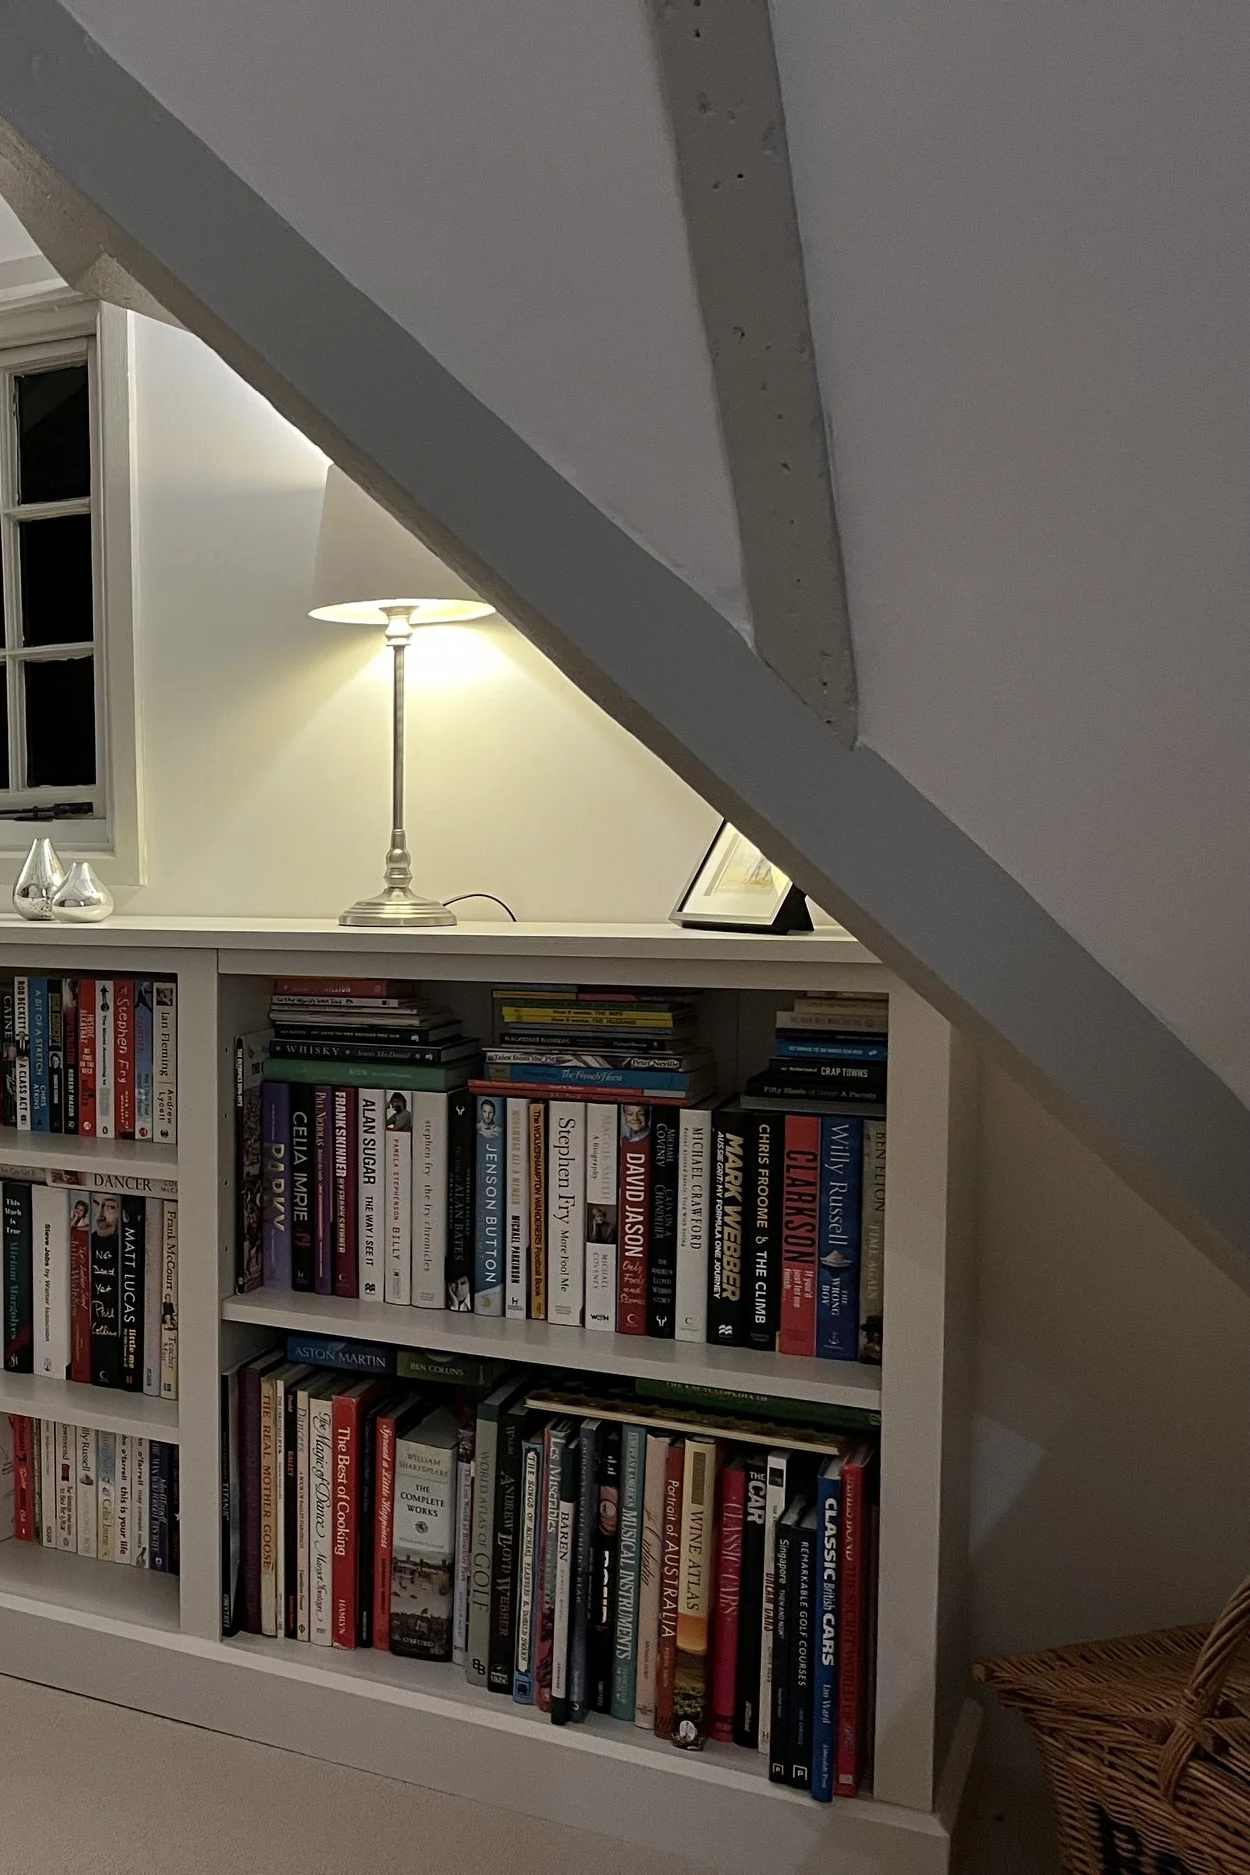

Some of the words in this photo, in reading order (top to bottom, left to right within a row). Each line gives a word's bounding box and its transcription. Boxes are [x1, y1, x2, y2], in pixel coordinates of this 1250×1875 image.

[4, 995, 13, 1038] CAINE
[36, 1014, 41, 1026] OF
[117, 997, 129, 1054] Stephen
[161, 1012, 170, 1028] Ian
[118, 1059, 128, 1083] Fry
[161, 1033, 170, 1077] Fleming
[286, 1045, 339, 1056] WHISKY
[653, 1060, 680, 1068] Neville
[19, 1071, 27, 1094] CLASS
[821, 1067, 840, 1076] CRAP
[842, 1068, 868, 1078] TOWNS
[315, 1091, 326, 1110] PAUL
[336, 1091, 346, 1126] FRANK
[363, 1099, 376, 1134] ALAN
[293, 1111, 307, 1165] CELIA
[315, 1111, 325, 1146] NICHOLAS
[423, 1120, 433, 1158] stephen
[758, 1124, 770, 1165] CHRIS
[825, 1124, 850, 1174] Willy
[335, 1128, 346, 1177] SKINNER
[363, 1138, 376, 1185] SUGAR
[423, 1162, 433, 1176] fry
[554, 1118, 576, 1188] Stephen
[692, 1127, 703, 1179] MICHAEL
[724, 1133, 743, 1202] MARK
[94, 1174, 152, 1191] DANCER
[294, 1172, 308, 1222] IMRIE
[424, 1185, 432, 1201] the
[485, 1144, 497, 1209] JENSON
[625, 1153, 645, 1200] DAVID
[423, 1203, 433, 1218] fry
[453, 1184, 464, 1218] ALAN
[554, 1194, 575, 1224] Fry
[691, 1185, 703, 1249] CRAWFORD
[756, 1169, 769, 1228] FROOME
[784, 1151, 817, 1264] CLARKSON
[828, 1182, 847, 1245] Russell
[167, 1210, 175, 1241] Frank
[454, 1223, 464, 1261] BATES
[511, 1215, 520, 1243] MICHAEL
[561, 1230, 569, 1251] More
[625, 1205, 643, 1257] JASON
[124, 1227, 135, 1268] MATT
[166, 1244, 174, 1290] McCourt
[366, 1258, 373, 1266] IT
[423, 1222, 433, 1272] chronicles
[485, 1216, 496, 1282] BUTTON
[511, 1246, 520, 1284] PARKINSON
[534, 1247, 542, 1276] Football
[561, 1256, 569, 1275] Fool
[722, 1206, 741, 1301] WEBBER
[756, 1251, 767, 1277] THE
[124, 1274, 135, 1323] LUCAS
[561, 1277, 569, 1292] Me
[755, 1282, 766, 1323] CLIMB
[294, 1346, 333, 1361] ASTON
[339, 1349, 386, 1367] MARTIN
[410, 1363, 426, 1371] BEN
[428, 1364, 464, 1376] COLLINS
[263, 1394, 272, 1418] THE
[263, 1425, 272, 1459] REAL
[314, 1431, 331, 1468] Magic
[338, 1427, 349, 1453] The
[314, 1469, 330, 1486] of
[337, 1455, 349, 1483] Best
[479, 1451, 490, 1494] WORLD
[263, 1465, 272, 1518] MOTHER
[315, 1483, 330, 1538] Dance
[337, 1485, 348, 1499] of
[500, 1471, 515, 1531] ANDREW
[667, 1480, 679, 1521] Portrait
[747, 1480, 765, 1524] CAR
[334, 1502, 348, 1556] Cooking
[477, 1498, 488, 1530] ATLAS
[666, 1525, 677, 1536] of
[689, 1510, 702, 1554] WINE
[263, 1525, 272, 1570] GOOSE
[477, 1534, 487, 1548] OF
[621, 1509, 637, 1566] MUSICAL
[722, 1503, 739, 1568] CLASSIC
[823, 1498, 837, 1580] CLASSIC
[778, 1539, 789, 1584] Singapore
[798, 1542, 809, 1607] REMARKABLE
[473, 1553, 490, 1613] GOLF
[661, 1540, 677, 1638] AUSTRALIA
[686, 1560, 701, 1611] ATLAS
[720, 1575, 738, 1614] CARS
[823, 1582, 836, 1610] British
[338, 1599, 346, 1634] HAMLYN
[498, 1576, 509, 1636] WEBBER
[616, 1570, 634, 1659] INSTRUMENTS
[798, 1611, 808, 1637] GOLF
[822, 1613, 836, 1666] CARS
[797, 1640, 807, 1686] COURSES
